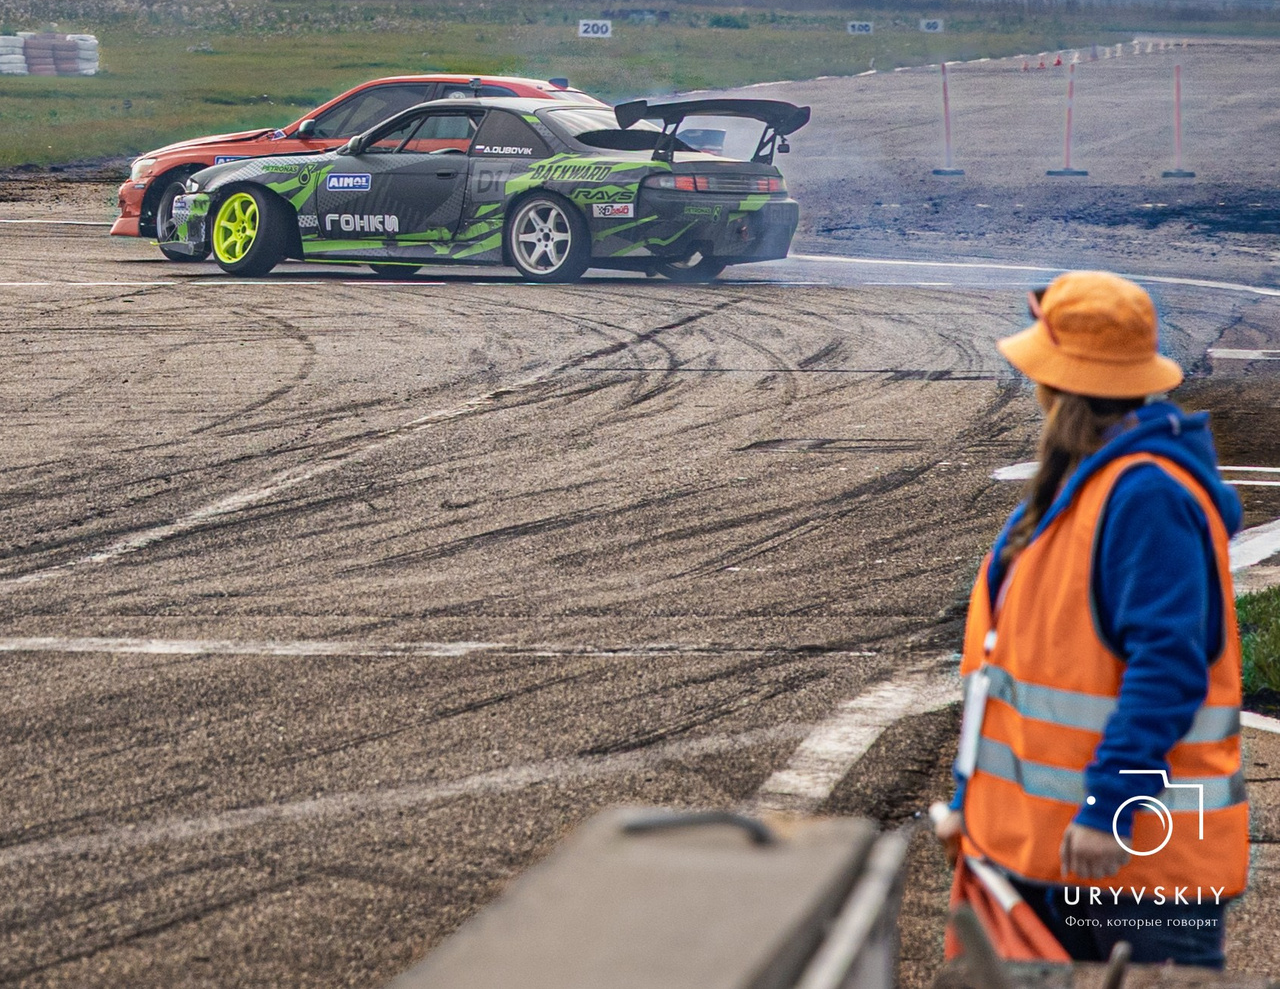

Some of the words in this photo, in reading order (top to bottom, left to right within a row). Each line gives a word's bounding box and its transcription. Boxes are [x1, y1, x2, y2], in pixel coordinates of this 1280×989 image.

[582, 23, 609, 35] 200
[529, 164, 612, 182] BACKWARD
[329, 177, 369, 188] AIMOL
[573, 189, 636, 202] RAYS
[325, 213, 399, 233] ГОНКИ
